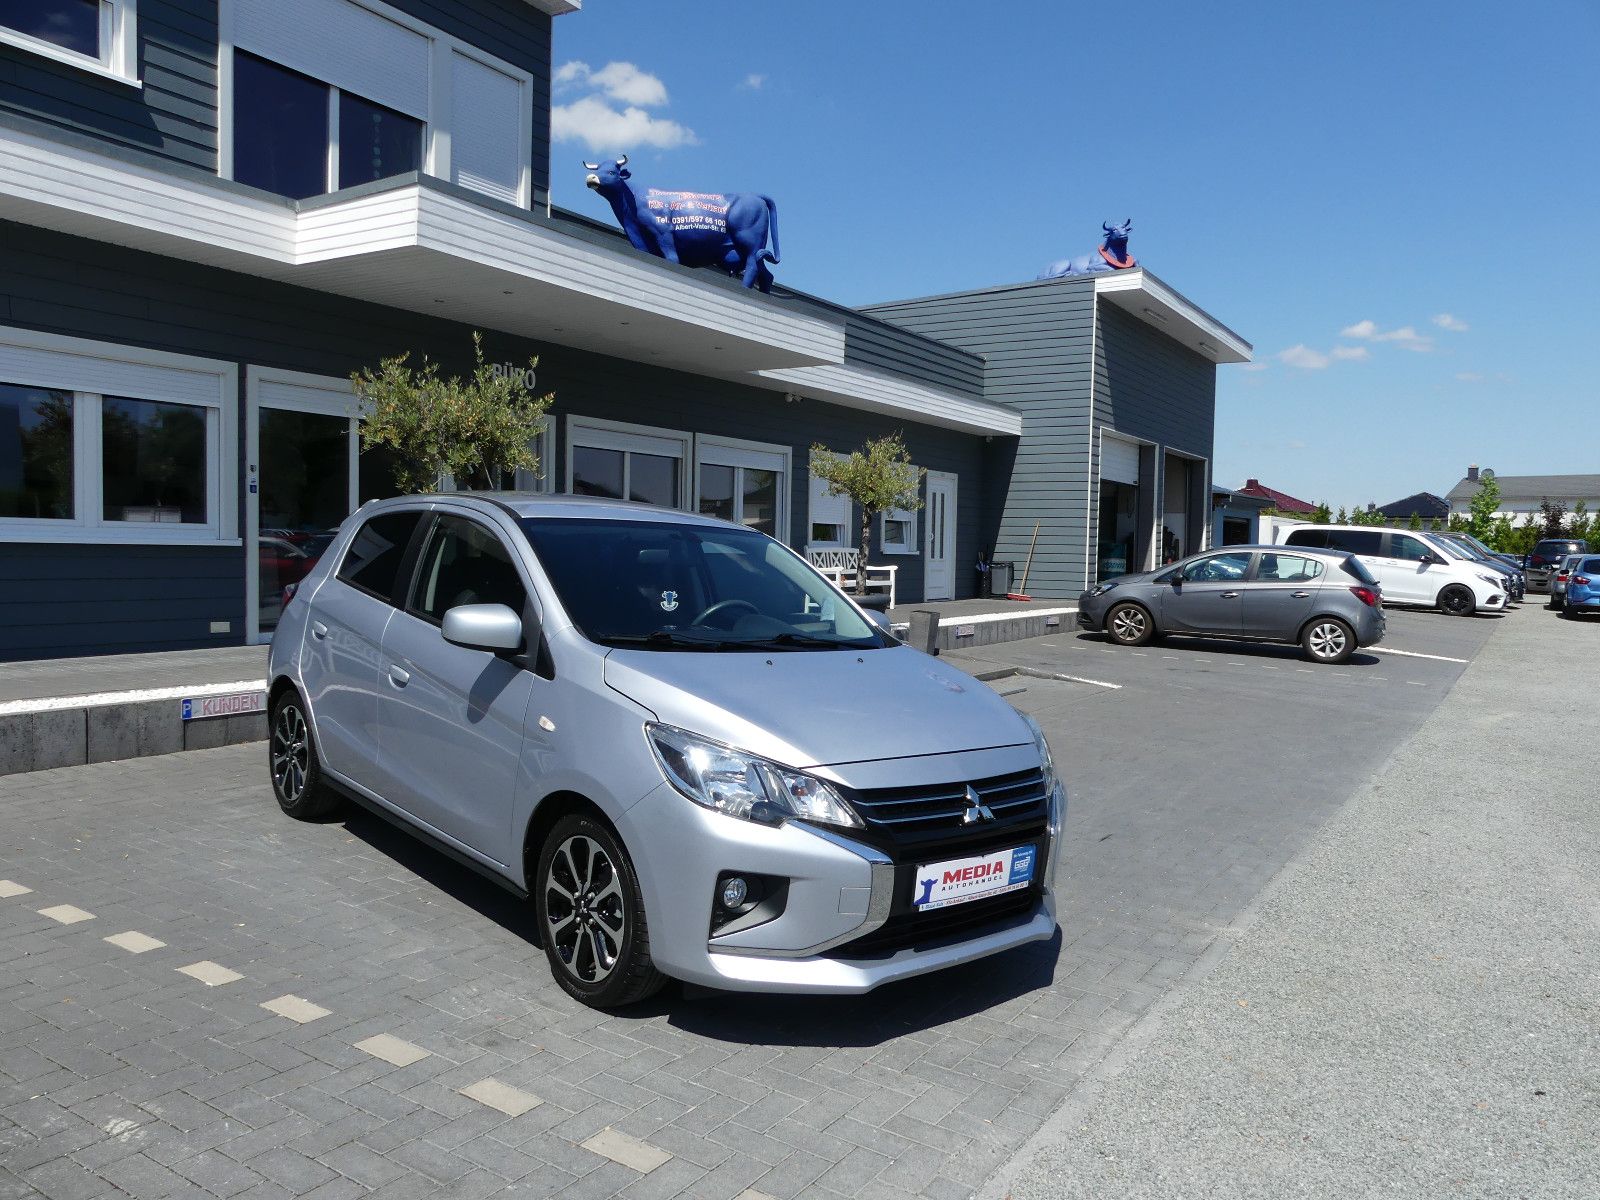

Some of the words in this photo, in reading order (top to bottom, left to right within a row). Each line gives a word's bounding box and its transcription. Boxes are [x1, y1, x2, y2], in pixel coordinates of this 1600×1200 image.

[656, 216, 670, 224] Tel.
[715, 218, 726, 227] 100
[183, 703, 192, 715] P
[201, 694, 259, 716] KUNDEN
[942, 861, 1003, 885] MEDIA
[942, 875, 1003, 891] AUTOHANDEL
